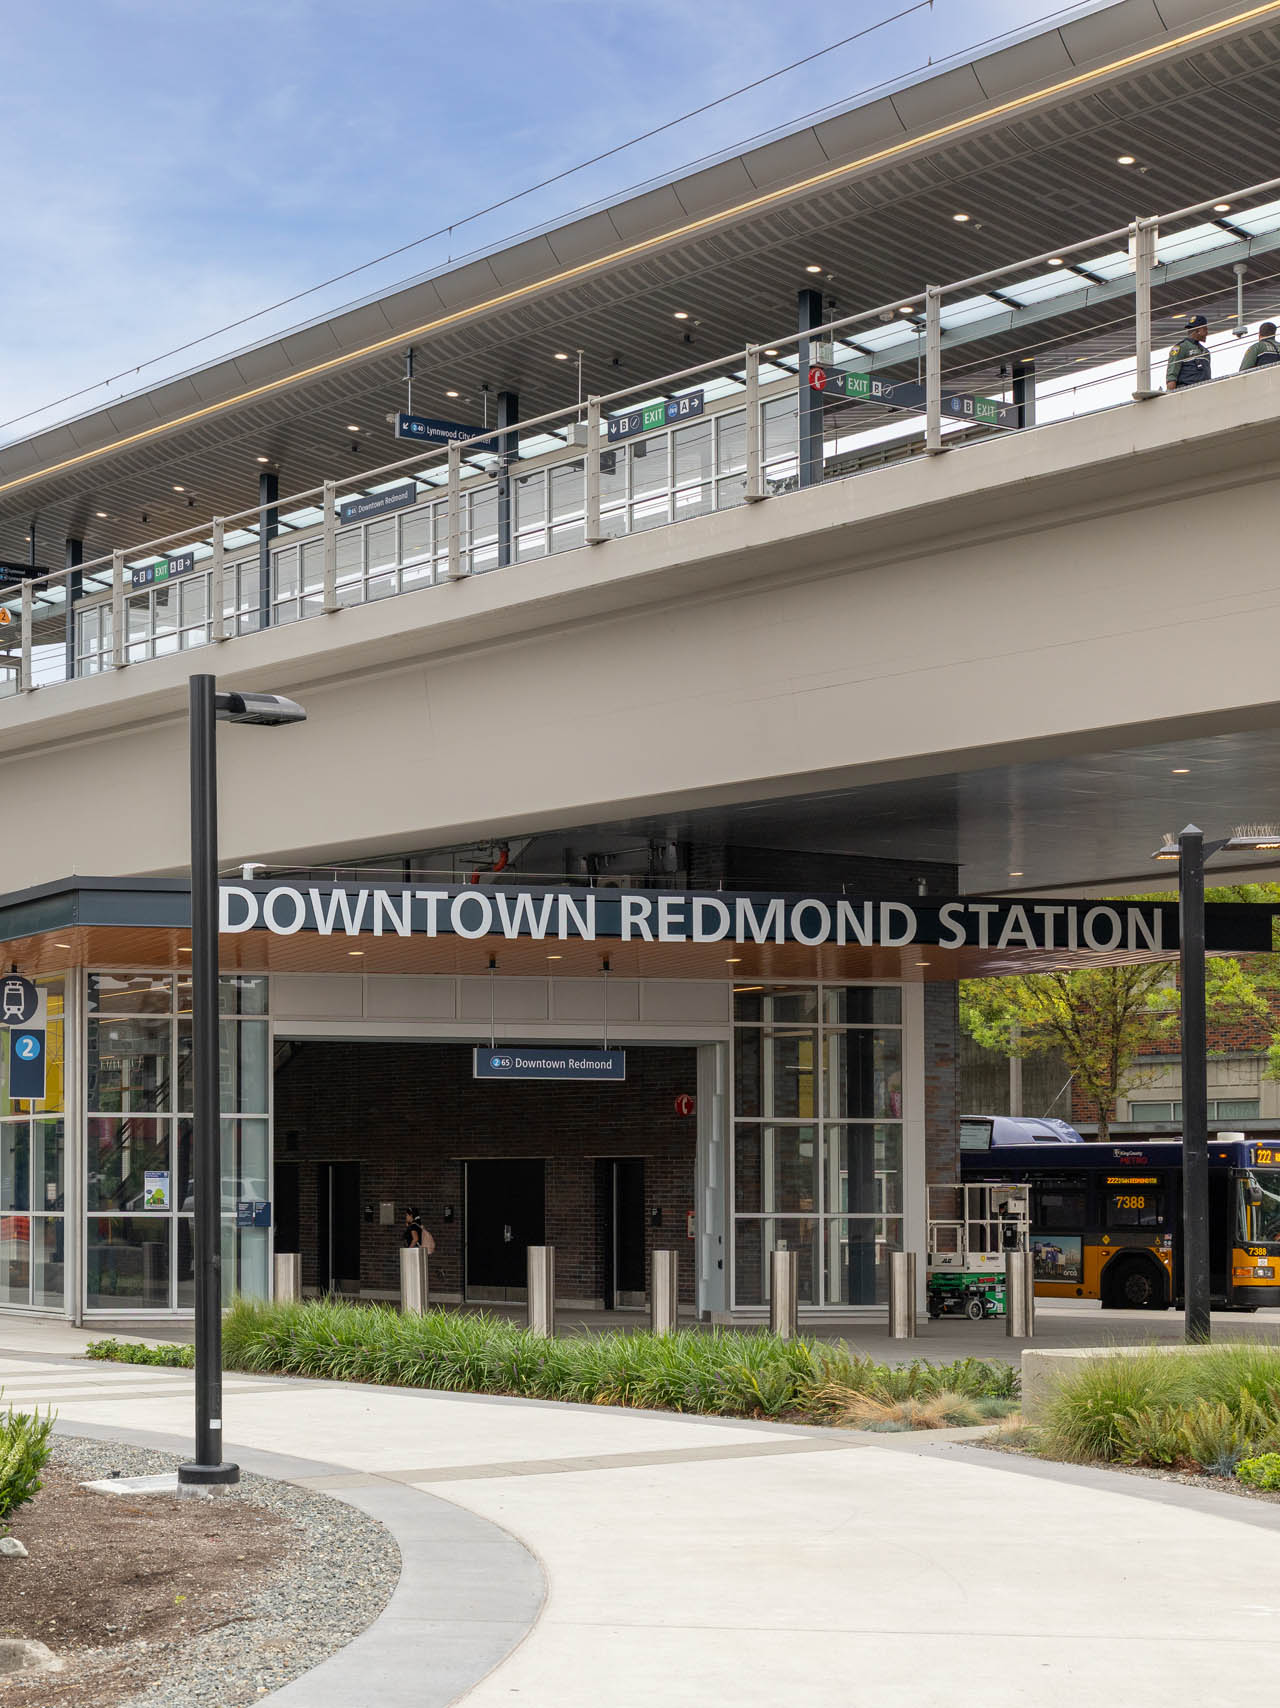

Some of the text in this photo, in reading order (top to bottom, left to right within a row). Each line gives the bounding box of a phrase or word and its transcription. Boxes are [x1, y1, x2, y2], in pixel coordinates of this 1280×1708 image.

[848, 379, 868, 393] EXIT
[644, 408, 663, 425] EXIT
[976, 405, 996, 418] EXIT
[426, 425, 457, 438] Lynnwood
[458, 431, 470, 441] City
[358, 499, 385, 513] Downtown
[385, 490, 409, 505] Redmond
[155, 565, 167, 577] EXIT
[1, 611, 7, 621] 2
[219, 886, 1163, 953] DOWNTOWN REDMOND STATION
[22, 1038, 34, 1057] 2
[515, 1057, 566, 1069] Downtown
[569, 1058, 613, 1070] Redmond
[1257, 1149, 1272, 1164] 222
[1115, 1196, 1145, 1209] 7388
[1248, 1247, 1267, 1256] 7388
